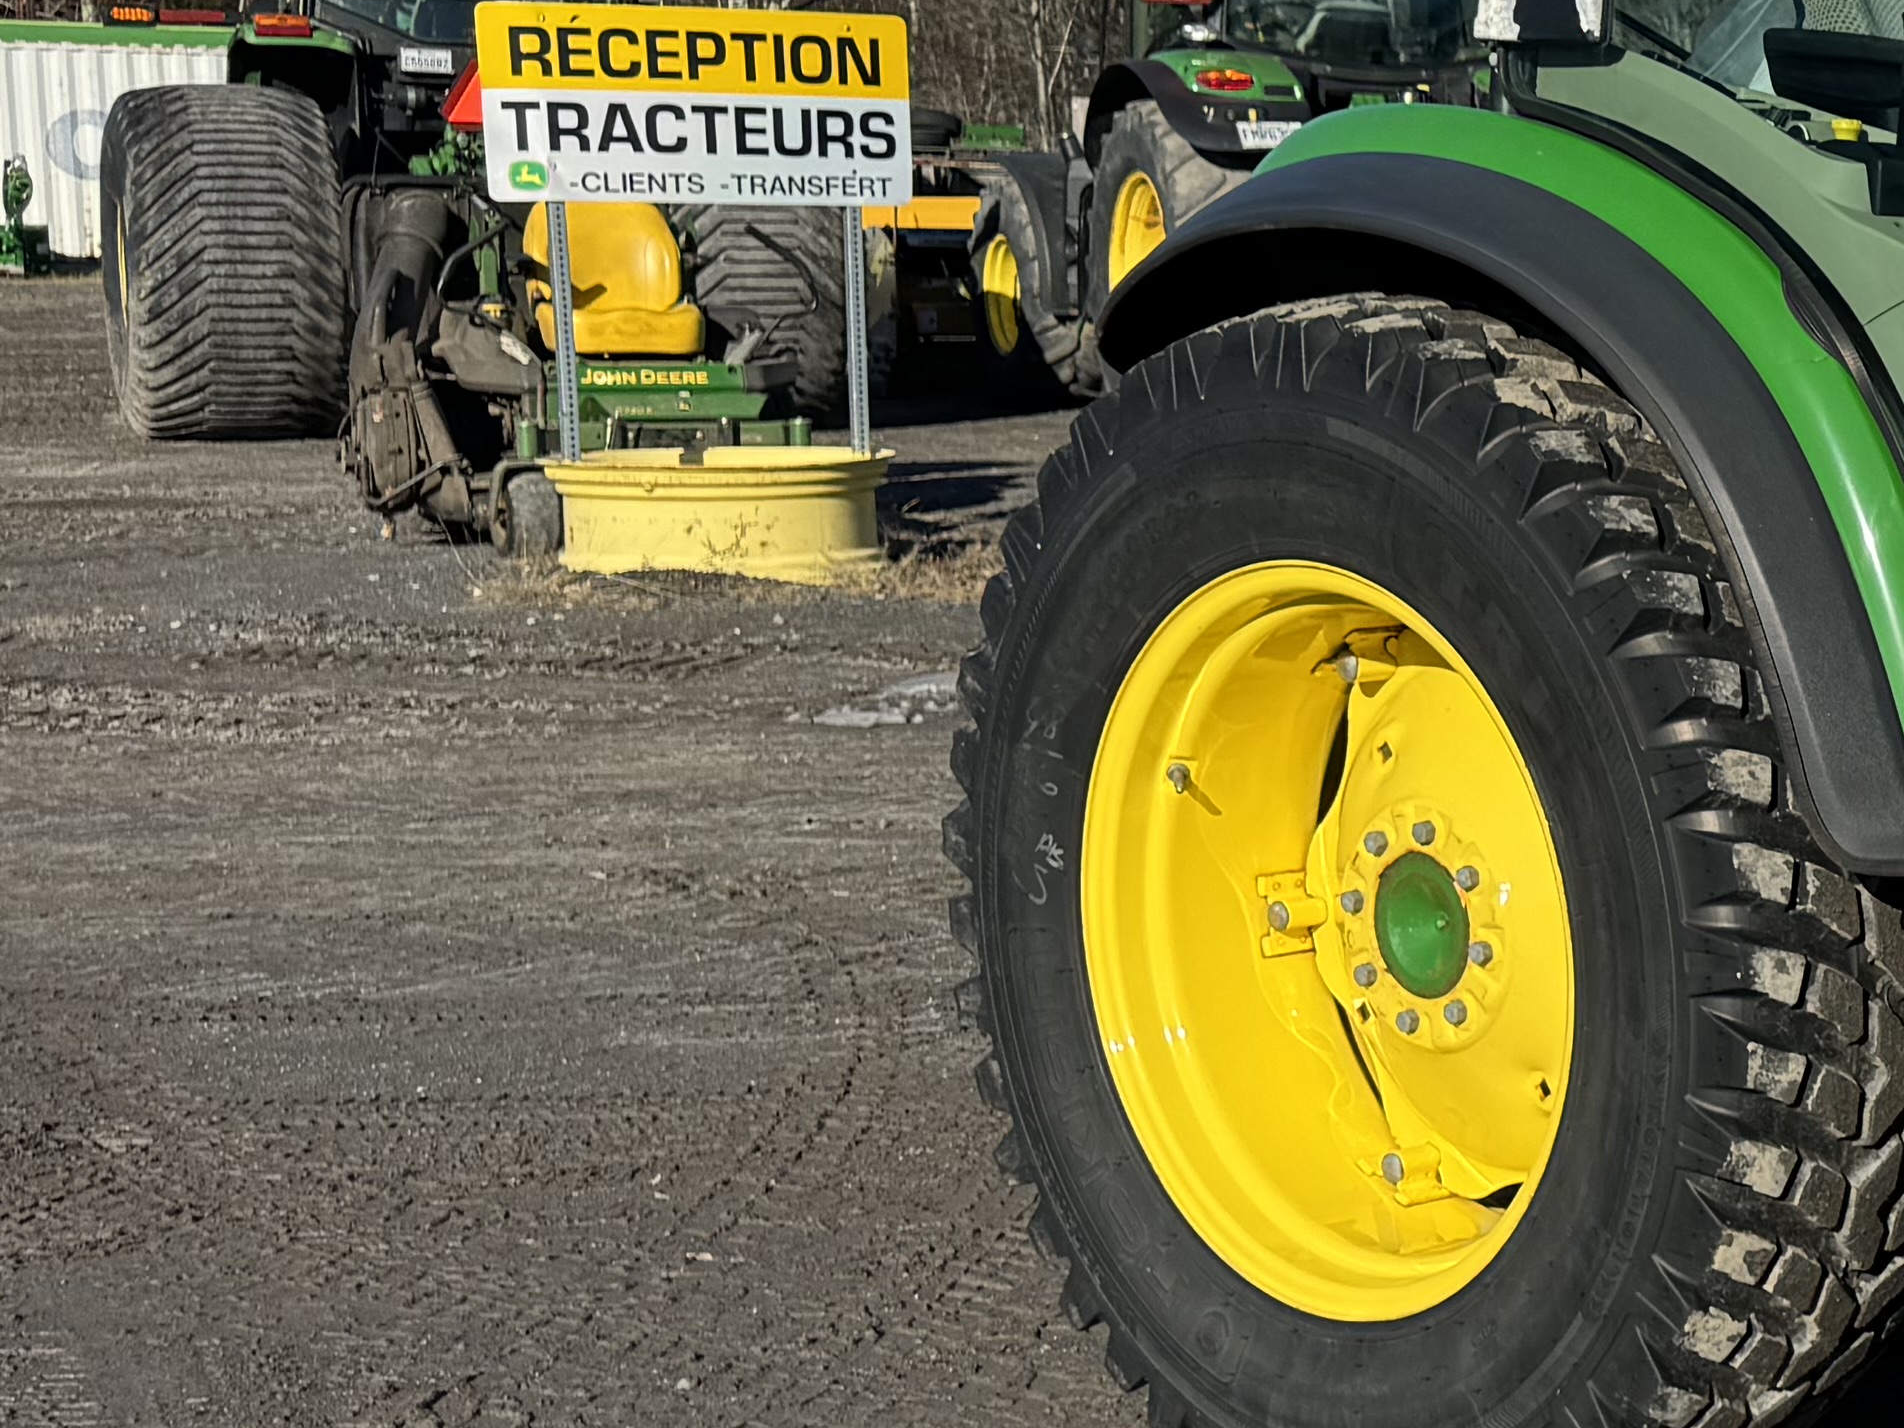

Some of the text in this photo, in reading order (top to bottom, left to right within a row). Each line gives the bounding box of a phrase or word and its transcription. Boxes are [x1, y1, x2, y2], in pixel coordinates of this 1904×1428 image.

[508, 14, 882, 86] RÉCEPTION
[501, 101, 897, 160] TRACTEURS
[581, 368, 709, 386] JOHN DEERE
